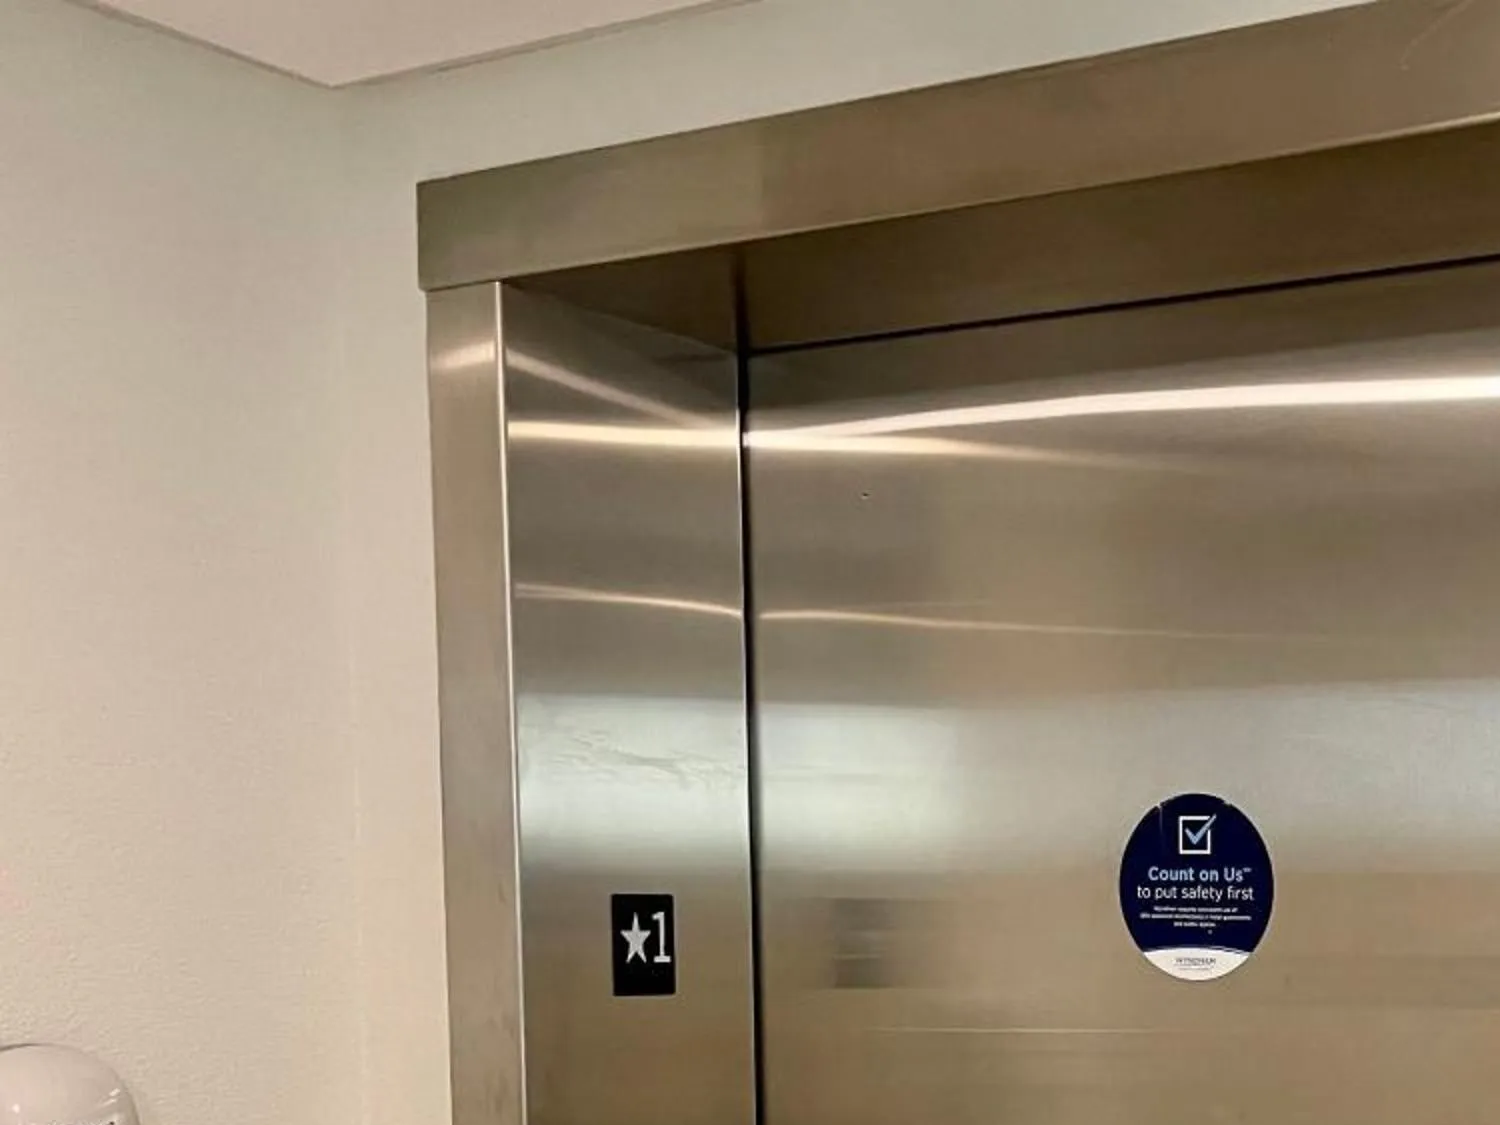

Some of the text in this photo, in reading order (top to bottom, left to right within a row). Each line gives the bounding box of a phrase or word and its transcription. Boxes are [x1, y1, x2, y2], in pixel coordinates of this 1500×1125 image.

[1147, 866, 1195, 881] Count
[1199, 869, 1219, 882] on
[1137, 885, 1254, 902] to put safety first
